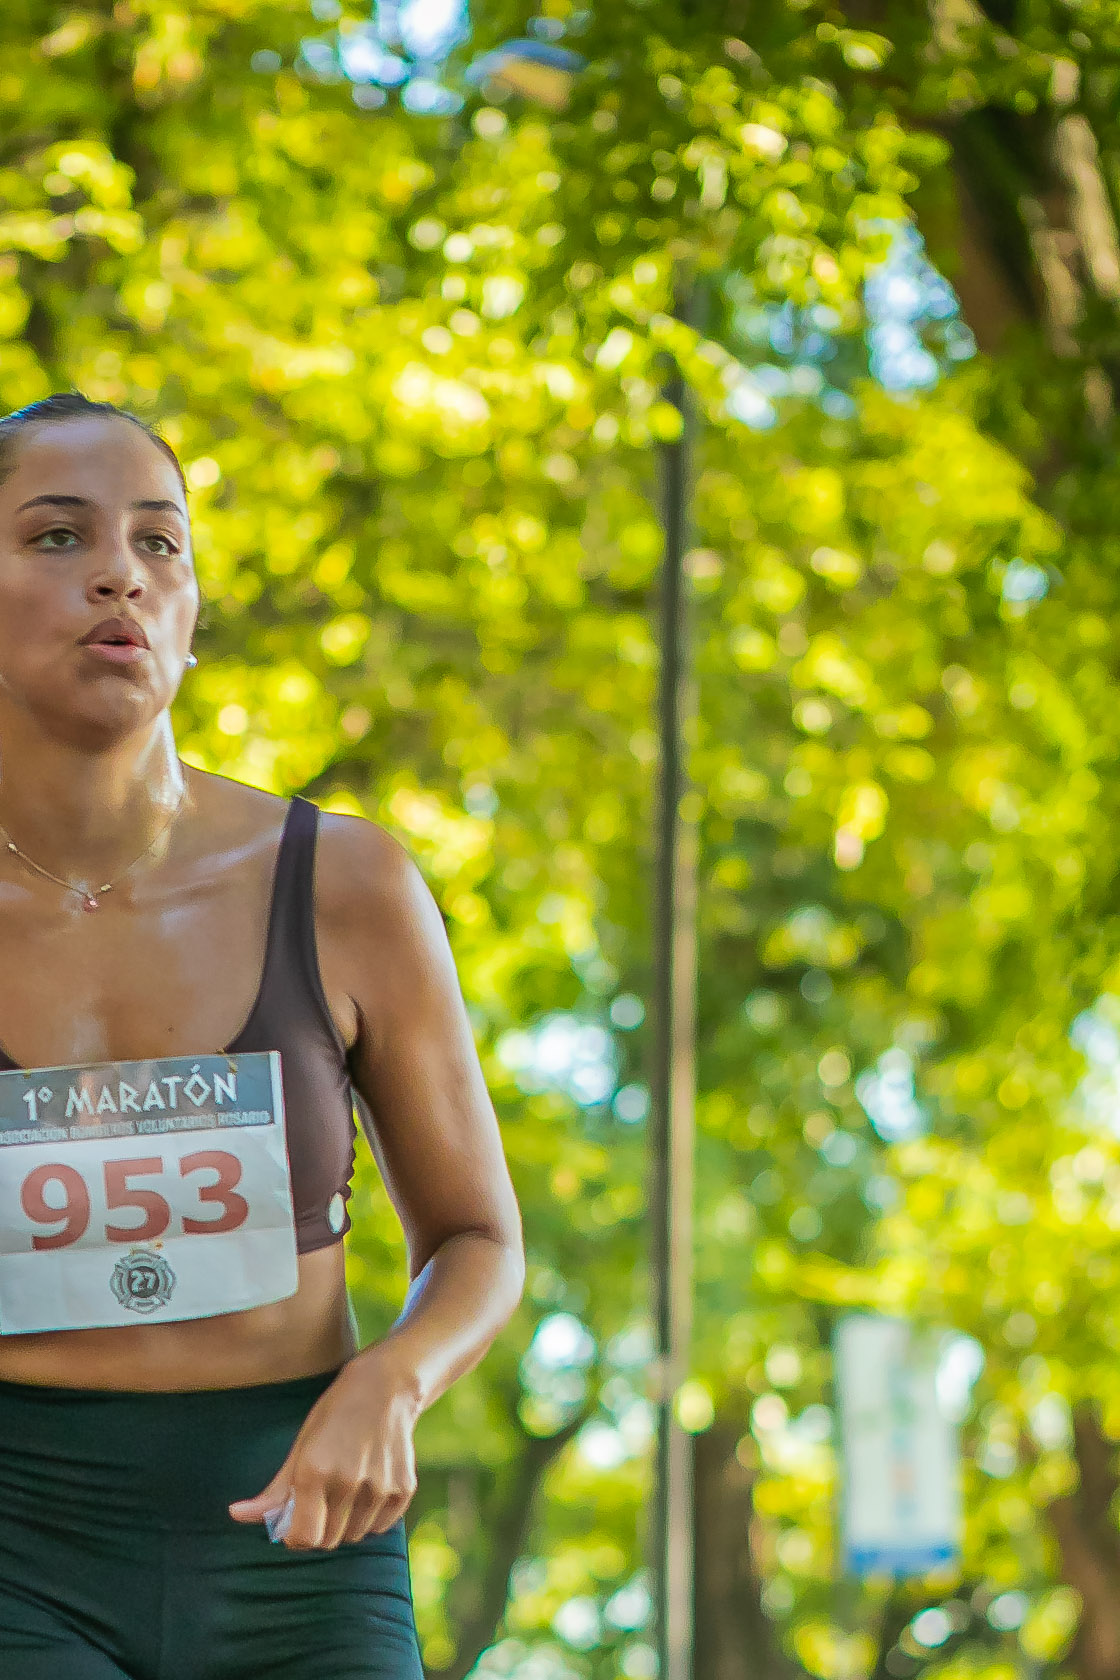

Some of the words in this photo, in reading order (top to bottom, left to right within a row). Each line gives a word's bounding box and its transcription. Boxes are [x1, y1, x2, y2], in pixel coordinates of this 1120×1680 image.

[64, 1064, 238, 1118] MARATÓN
[20, 1150, 249, 1251] 953
[131, 1270, 156, 1292] 27
